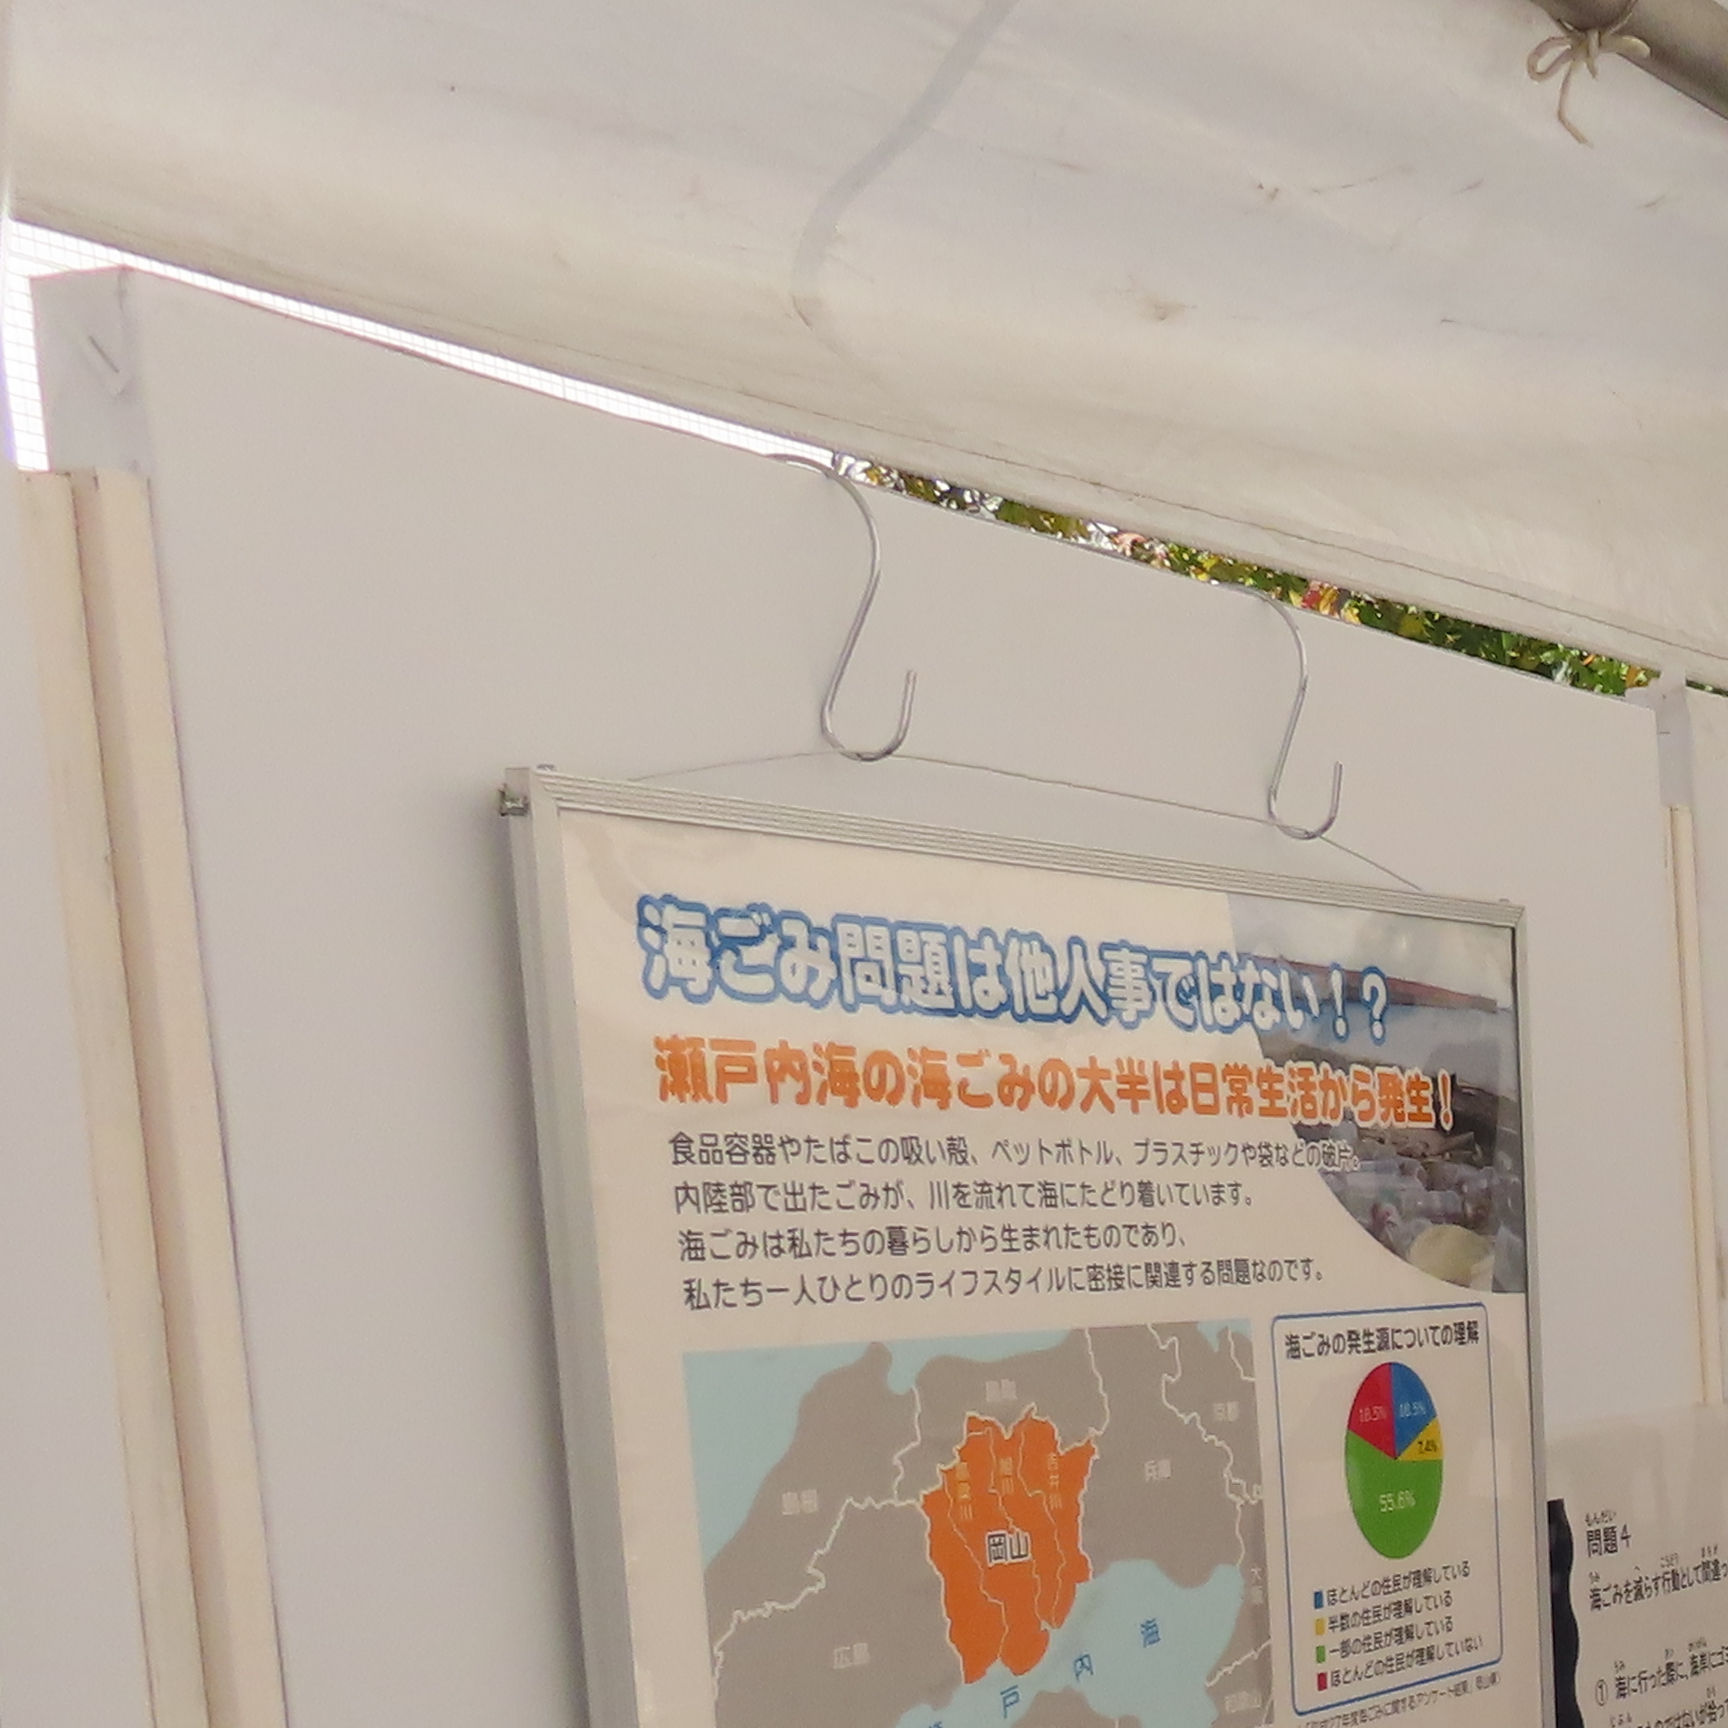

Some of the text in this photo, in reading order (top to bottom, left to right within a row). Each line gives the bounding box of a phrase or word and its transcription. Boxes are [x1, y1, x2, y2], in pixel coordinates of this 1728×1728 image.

[637, 895, 1391, 1043] 海ごみ問題は他人事ではない！？
[653, 1034, 1457, 1130] 瀬戸内海の海ごみの大半は日常生活から発生！
[679, 1225, 1187, 1262] 海ごみは私たちの暮らしから生まれたものであり、
[1286, 1321, 1479, 1359] 海ごみの発生源についての理解
[986, 1530, 1031, 1566] 岡山
[1327, 1561, 1470, 1606] ほとんどの住民が理解している
[1328, 1590, 1453, 1633] 半数の住民が理解している
[1329, 1616, 1453, 1658] 一部の住民が理解している
[1331, 1636, 1484, 1687] ほとんどの住民が理解していない
